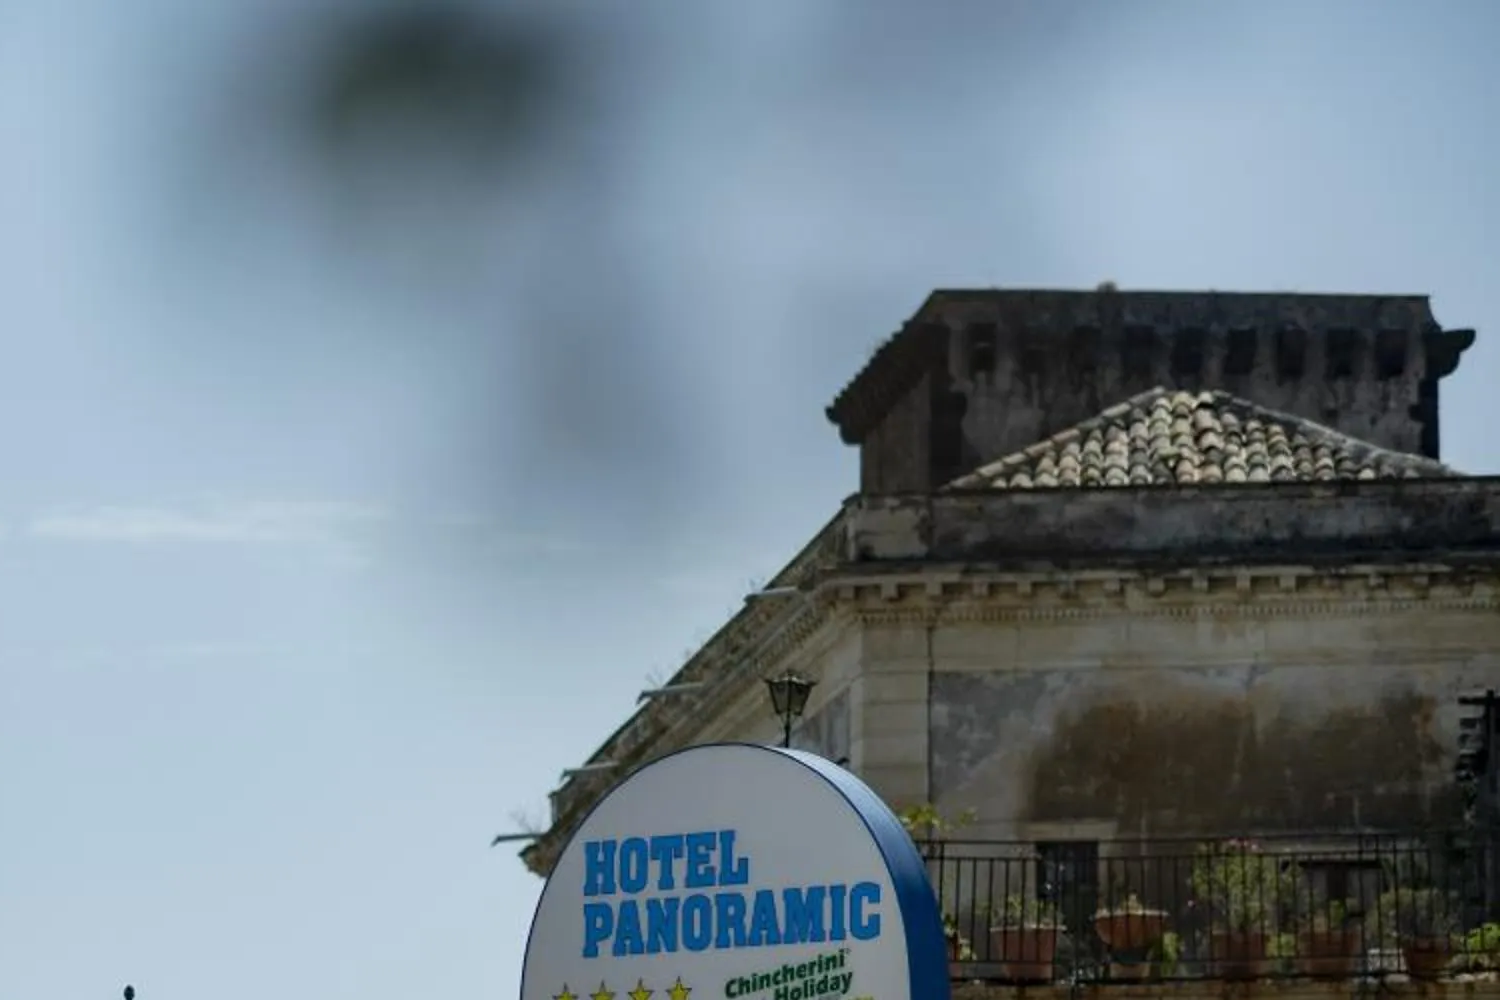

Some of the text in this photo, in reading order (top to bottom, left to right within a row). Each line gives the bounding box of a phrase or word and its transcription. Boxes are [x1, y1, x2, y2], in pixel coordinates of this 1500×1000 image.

[583, 829, 749, 896] HOTEL
[582, 881, 881, 958] PANORAMIC
[725, 948, 845, 998] Chincherini
